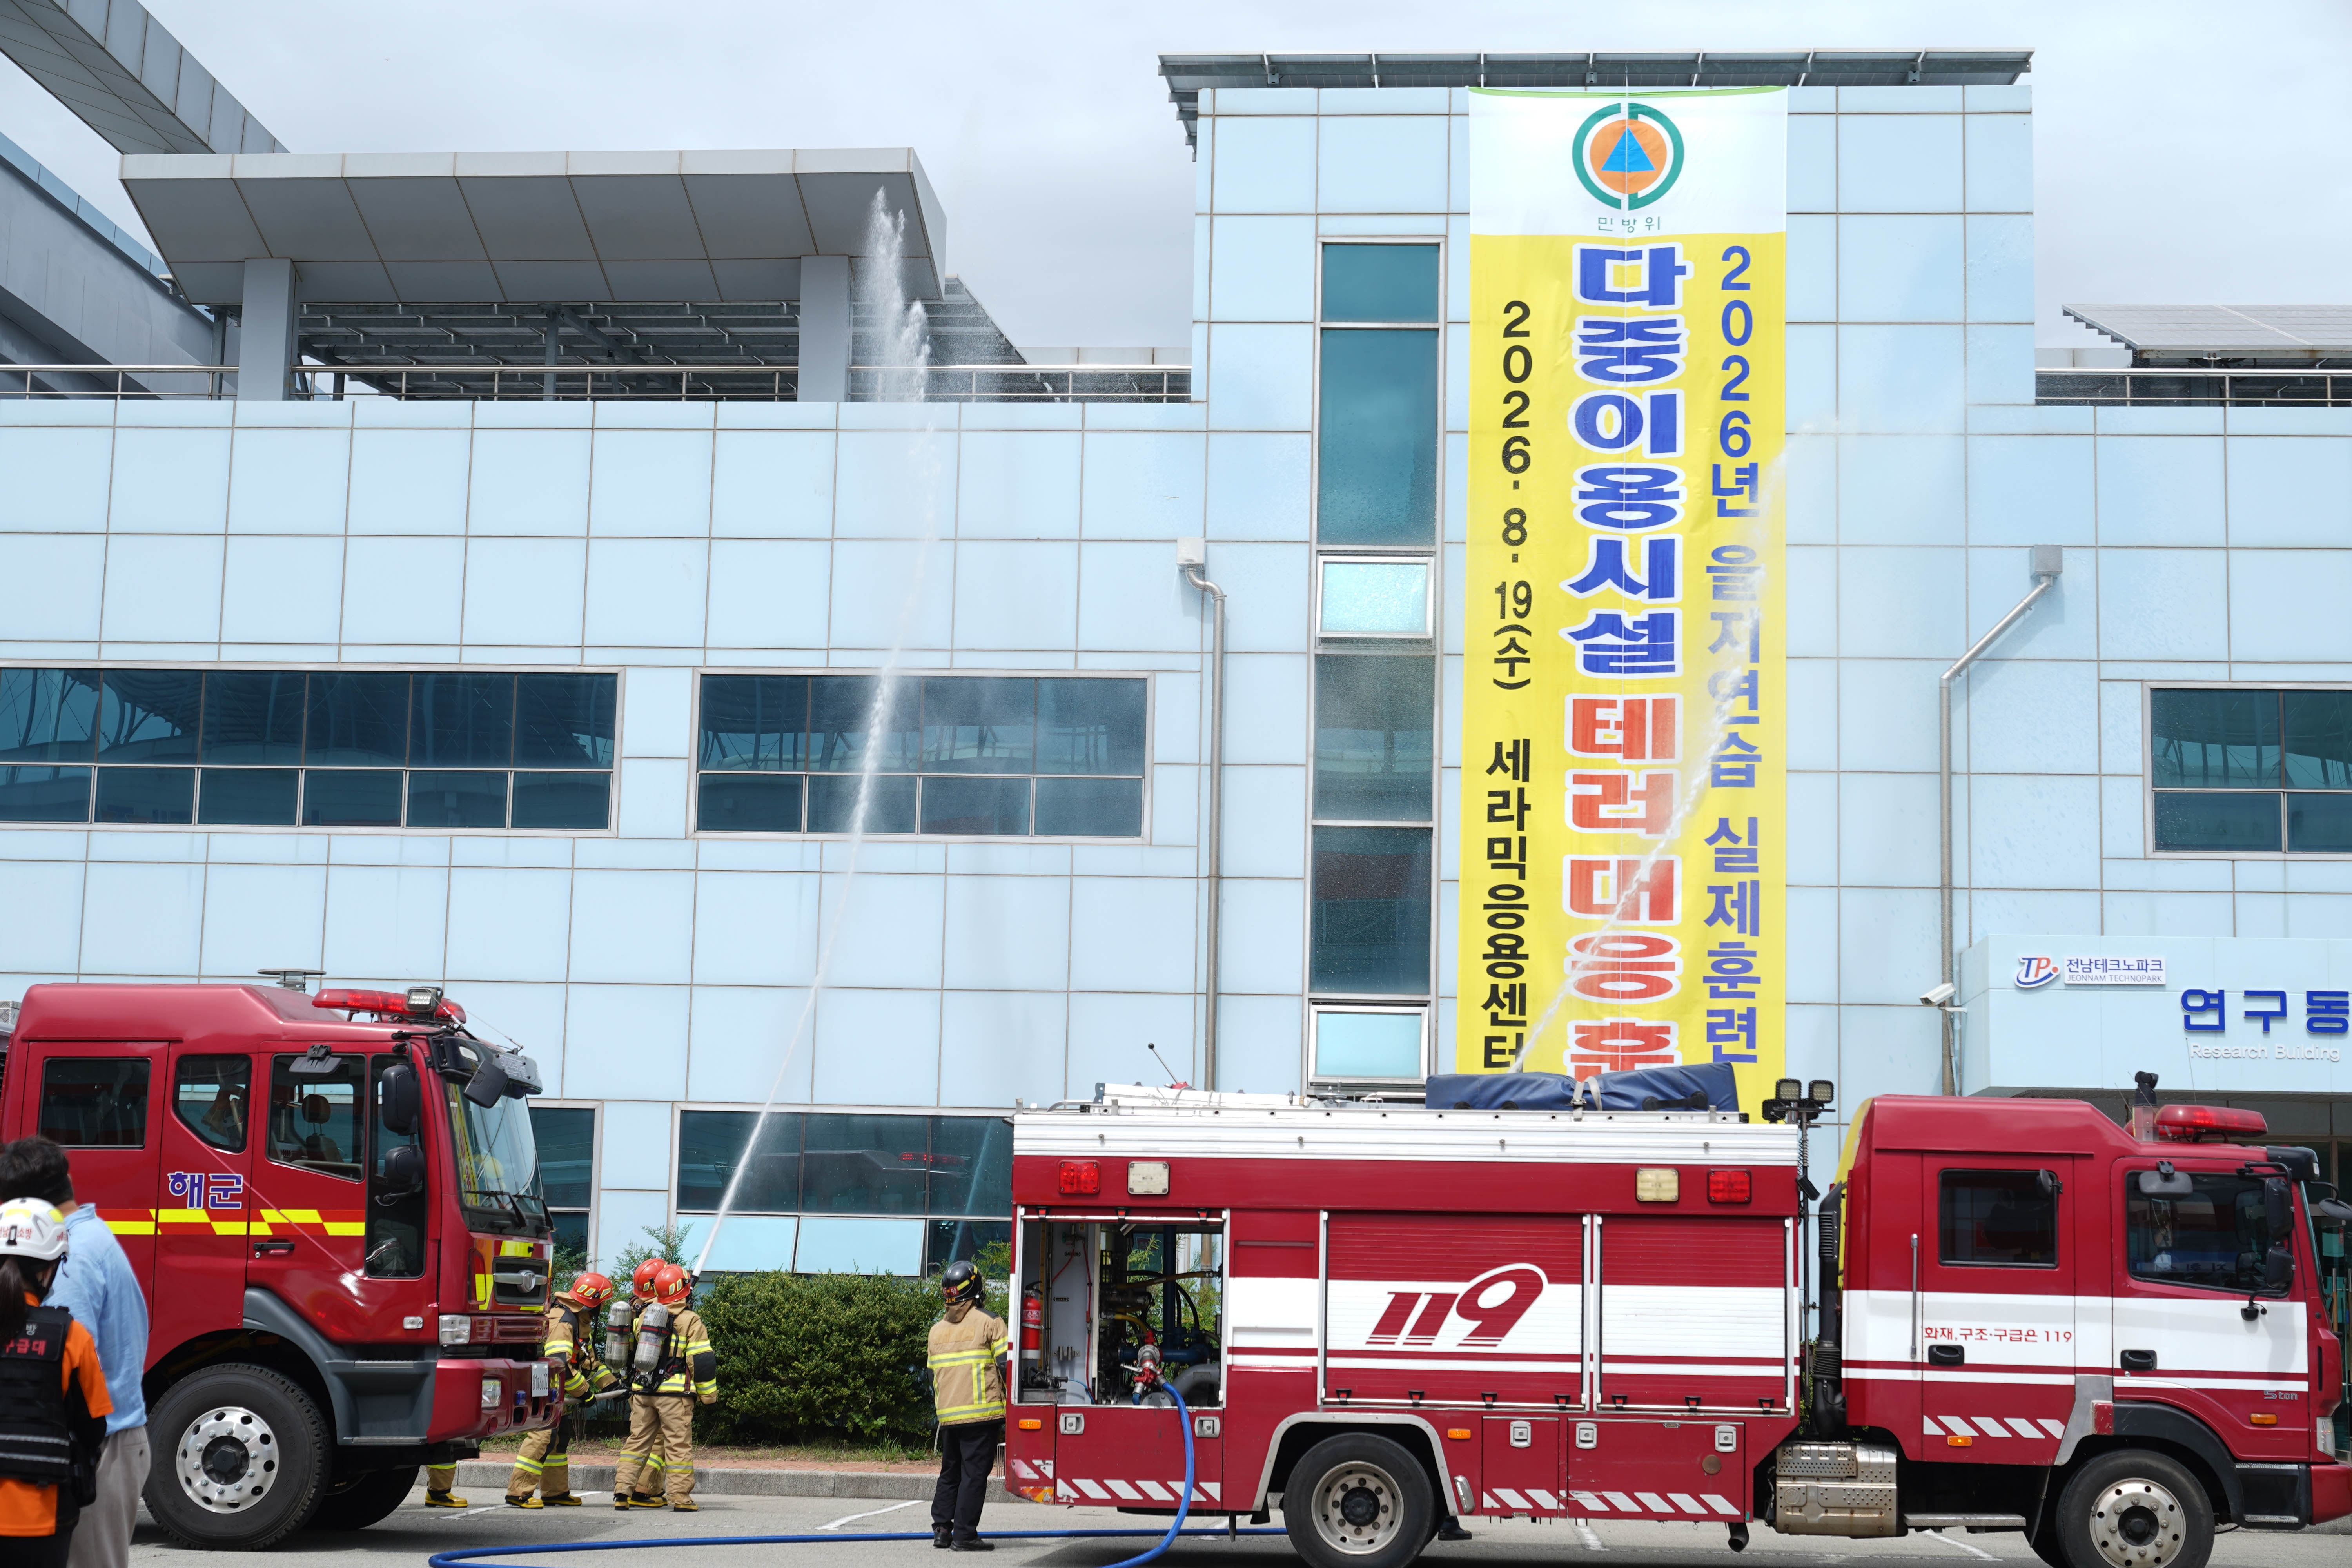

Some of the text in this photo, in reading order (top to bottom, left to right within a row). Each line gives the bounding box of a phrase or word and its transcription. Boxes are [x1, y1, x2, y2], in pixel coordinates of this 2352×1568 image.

[1598, 216, 1660, 233] 민방위
[1567, 247, 1686, 675] 다중이용시설
[1703, 245, 1762, 1063] 2026년 을지연습 실제훈련
[1481, 739, 1531, 1073] 세라믹응용센터
[2067, 958, 2163, 973] 전남테크노파크
[2181, 989, 2349, 1034] 연구동
[2190, 1043, 2340, 1062] Research Building
[167, 1171, 243, 1209] 해군
[1365, 1265, 1545, 1347] 119
[2044, 1331, 2072, 1342] 119
